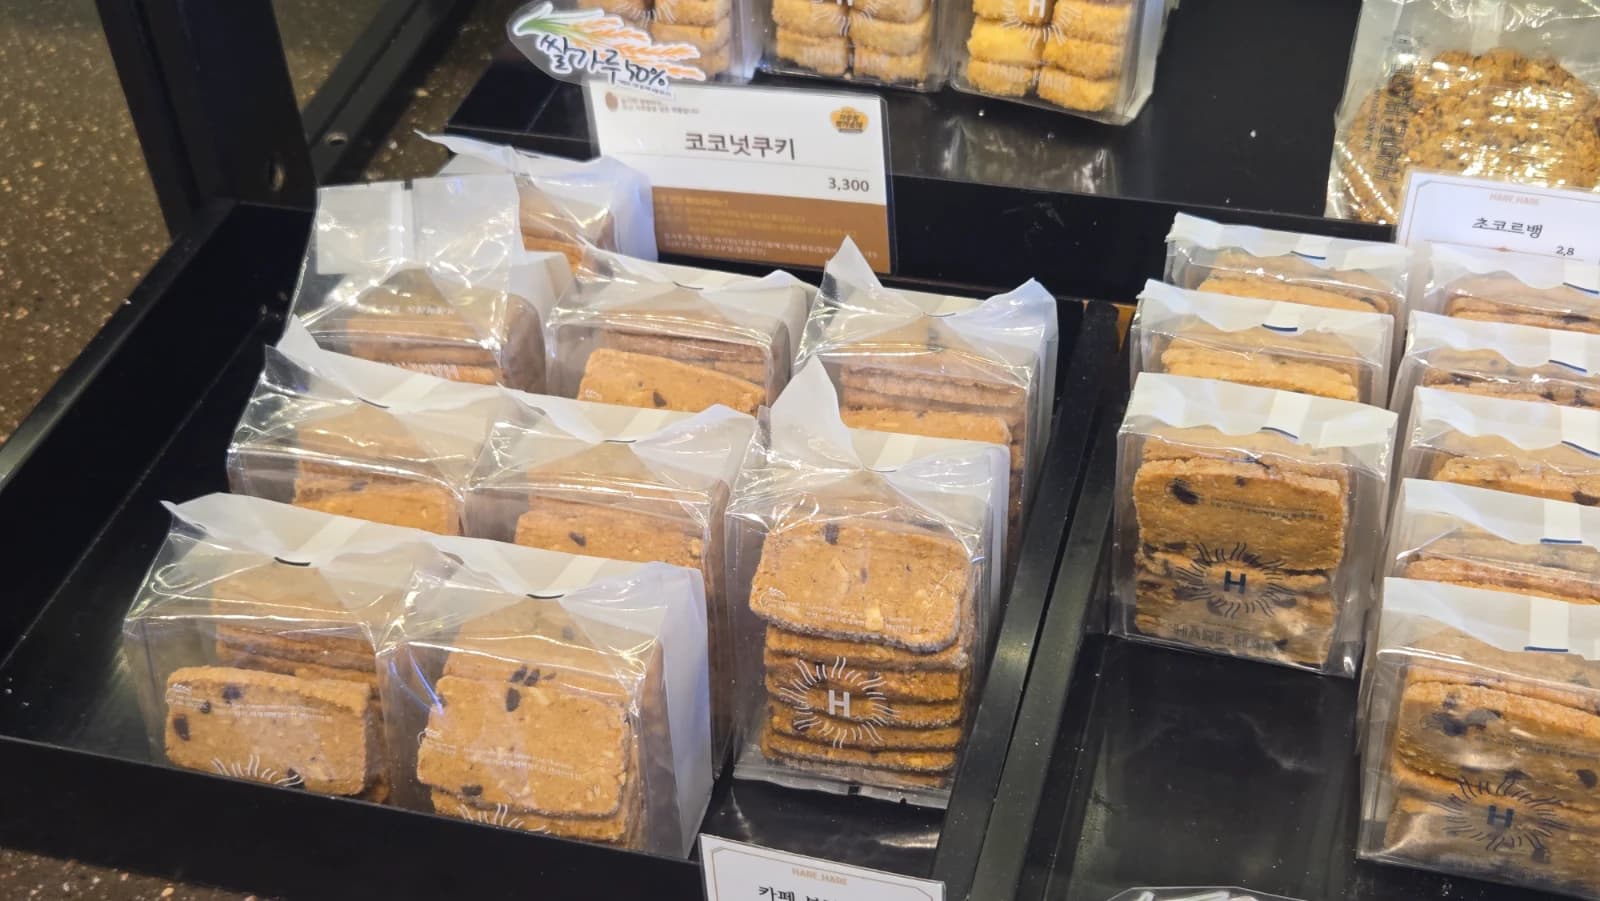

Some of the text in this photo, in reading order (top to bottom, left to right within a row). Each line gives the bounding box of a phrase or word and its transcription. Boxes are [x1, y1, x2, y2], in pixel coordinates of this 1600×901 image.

[540, 34, 667, 87] 쌀가루 50%
[685, 131, 796, 161] 코코넛쿠키
[828, 176, 870, 193] 3,300
[1471, 217, 1544, 239] 초코르뱅
[1224, 570, 1247, 594] H
[828, 689, 851, 718] H
[1487, 805, 1514, 828] H
[759, 886, 795, 901] 카페
